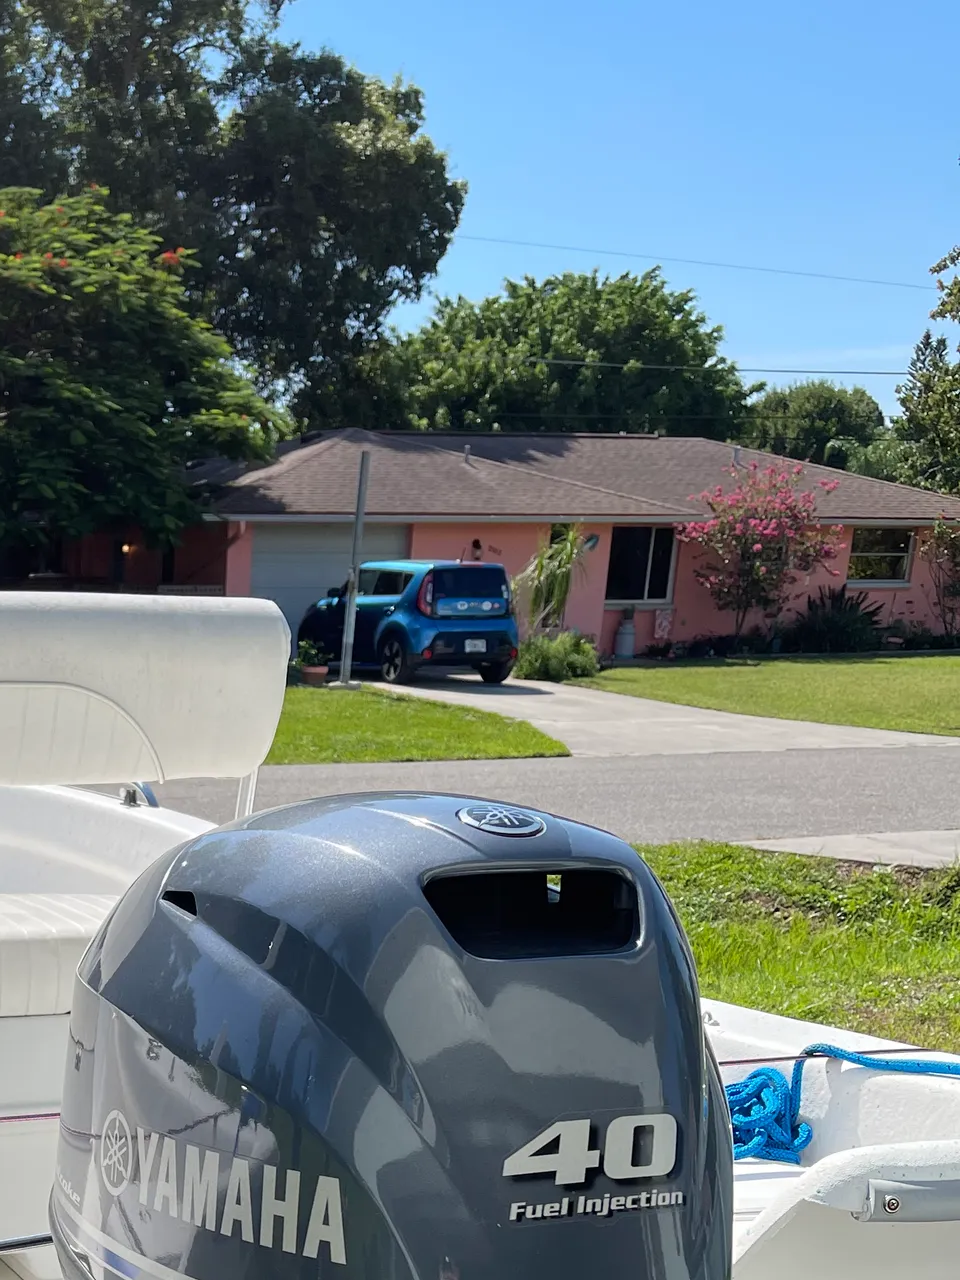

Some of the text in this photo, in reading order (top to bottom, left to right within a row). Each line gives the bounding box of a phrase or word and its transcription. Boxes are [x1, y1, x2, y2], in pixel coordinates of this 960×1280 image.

[502, 1113, 678, 1186] 40
[57, 1172, 81, 1207] roke
[136, 1126, 347, 1266] YAMAHA
[509, 1188, 683, 1221] Fuel Injection
